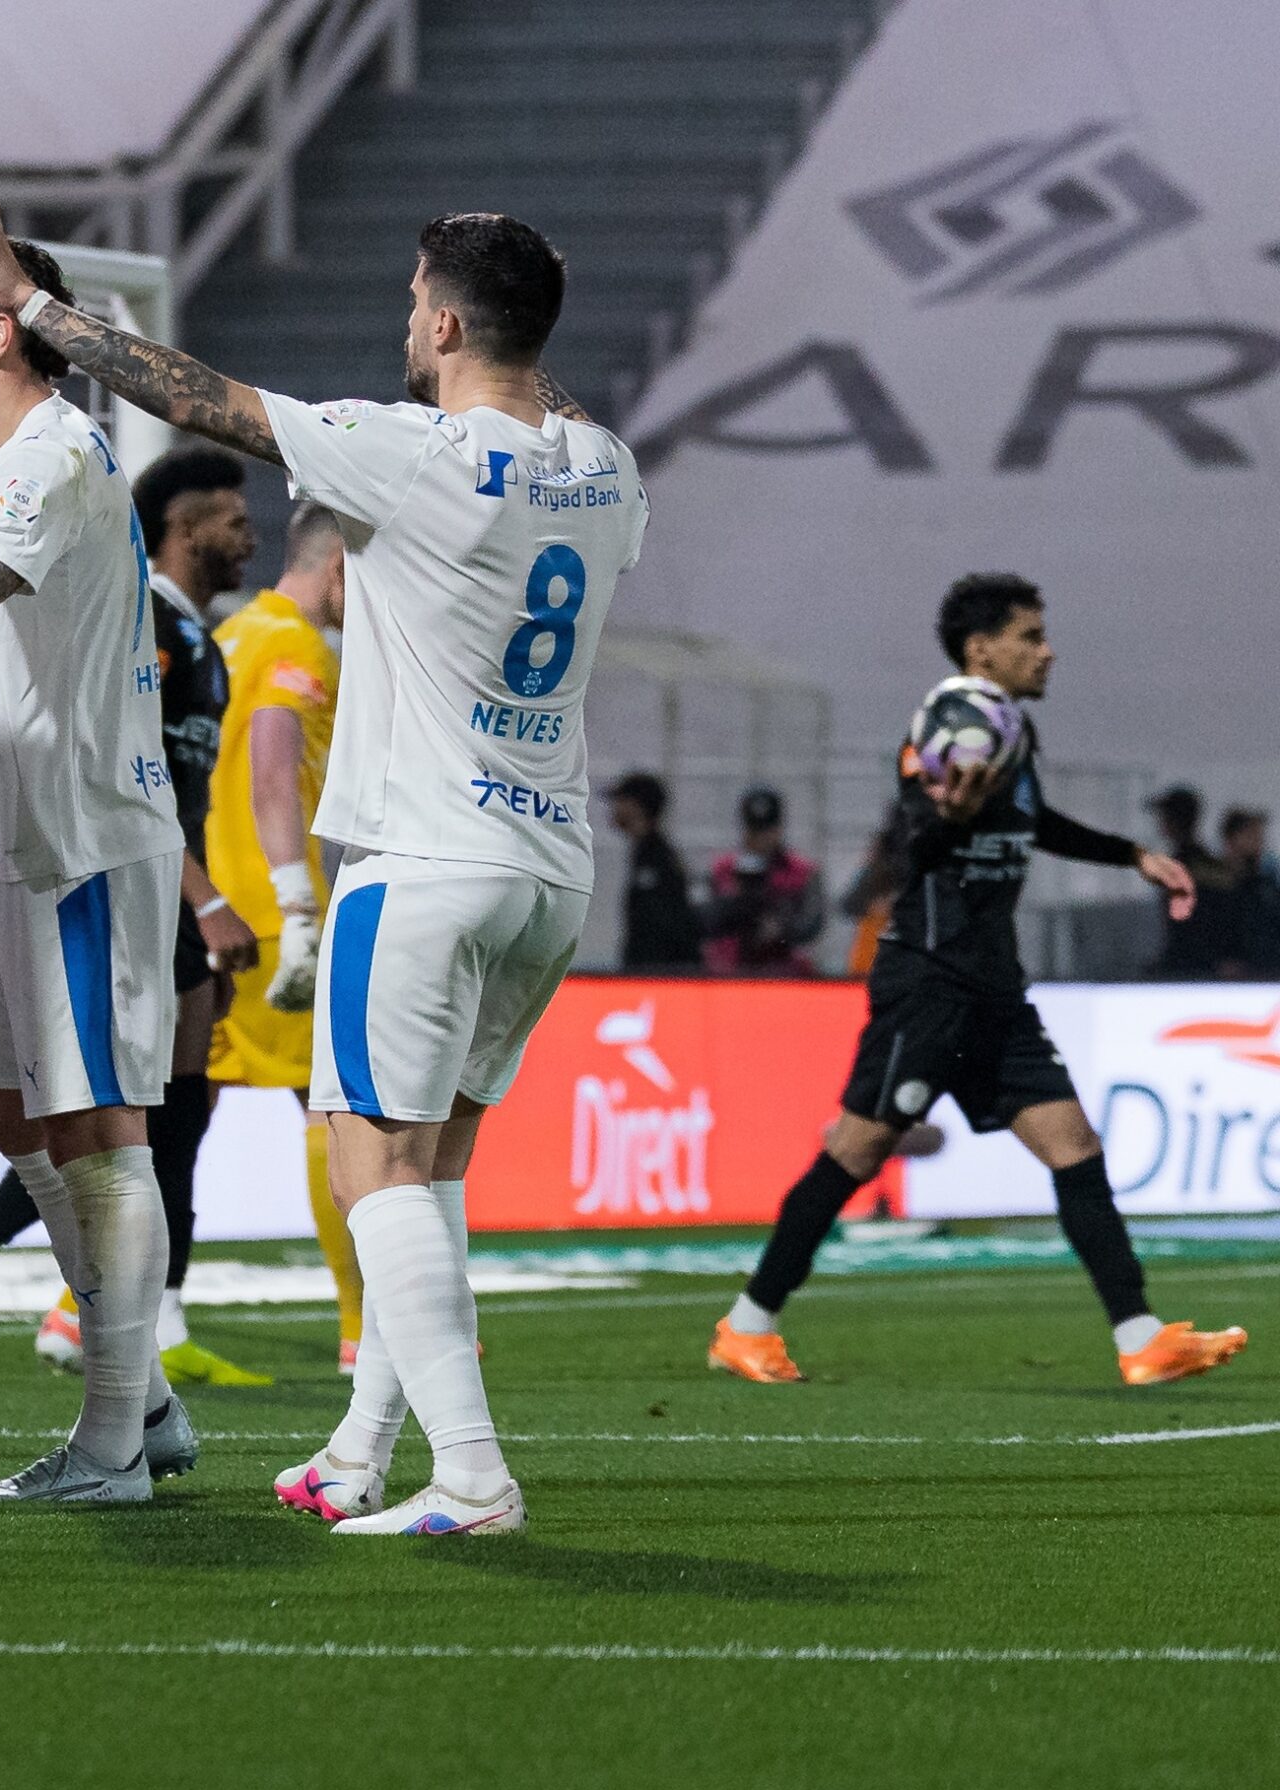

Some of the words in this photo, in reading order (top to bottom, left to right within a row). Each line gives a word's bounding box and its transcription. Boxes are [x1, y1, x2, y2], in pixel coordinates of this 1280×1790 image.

[528, 483, 581, 512] Riyad
[585, 484, 623, 508] Bank
[502, 544, 586, 698] 8
[470, 701, 564, 744] NEVES
[571, 1075, 715, 1214] Direct
